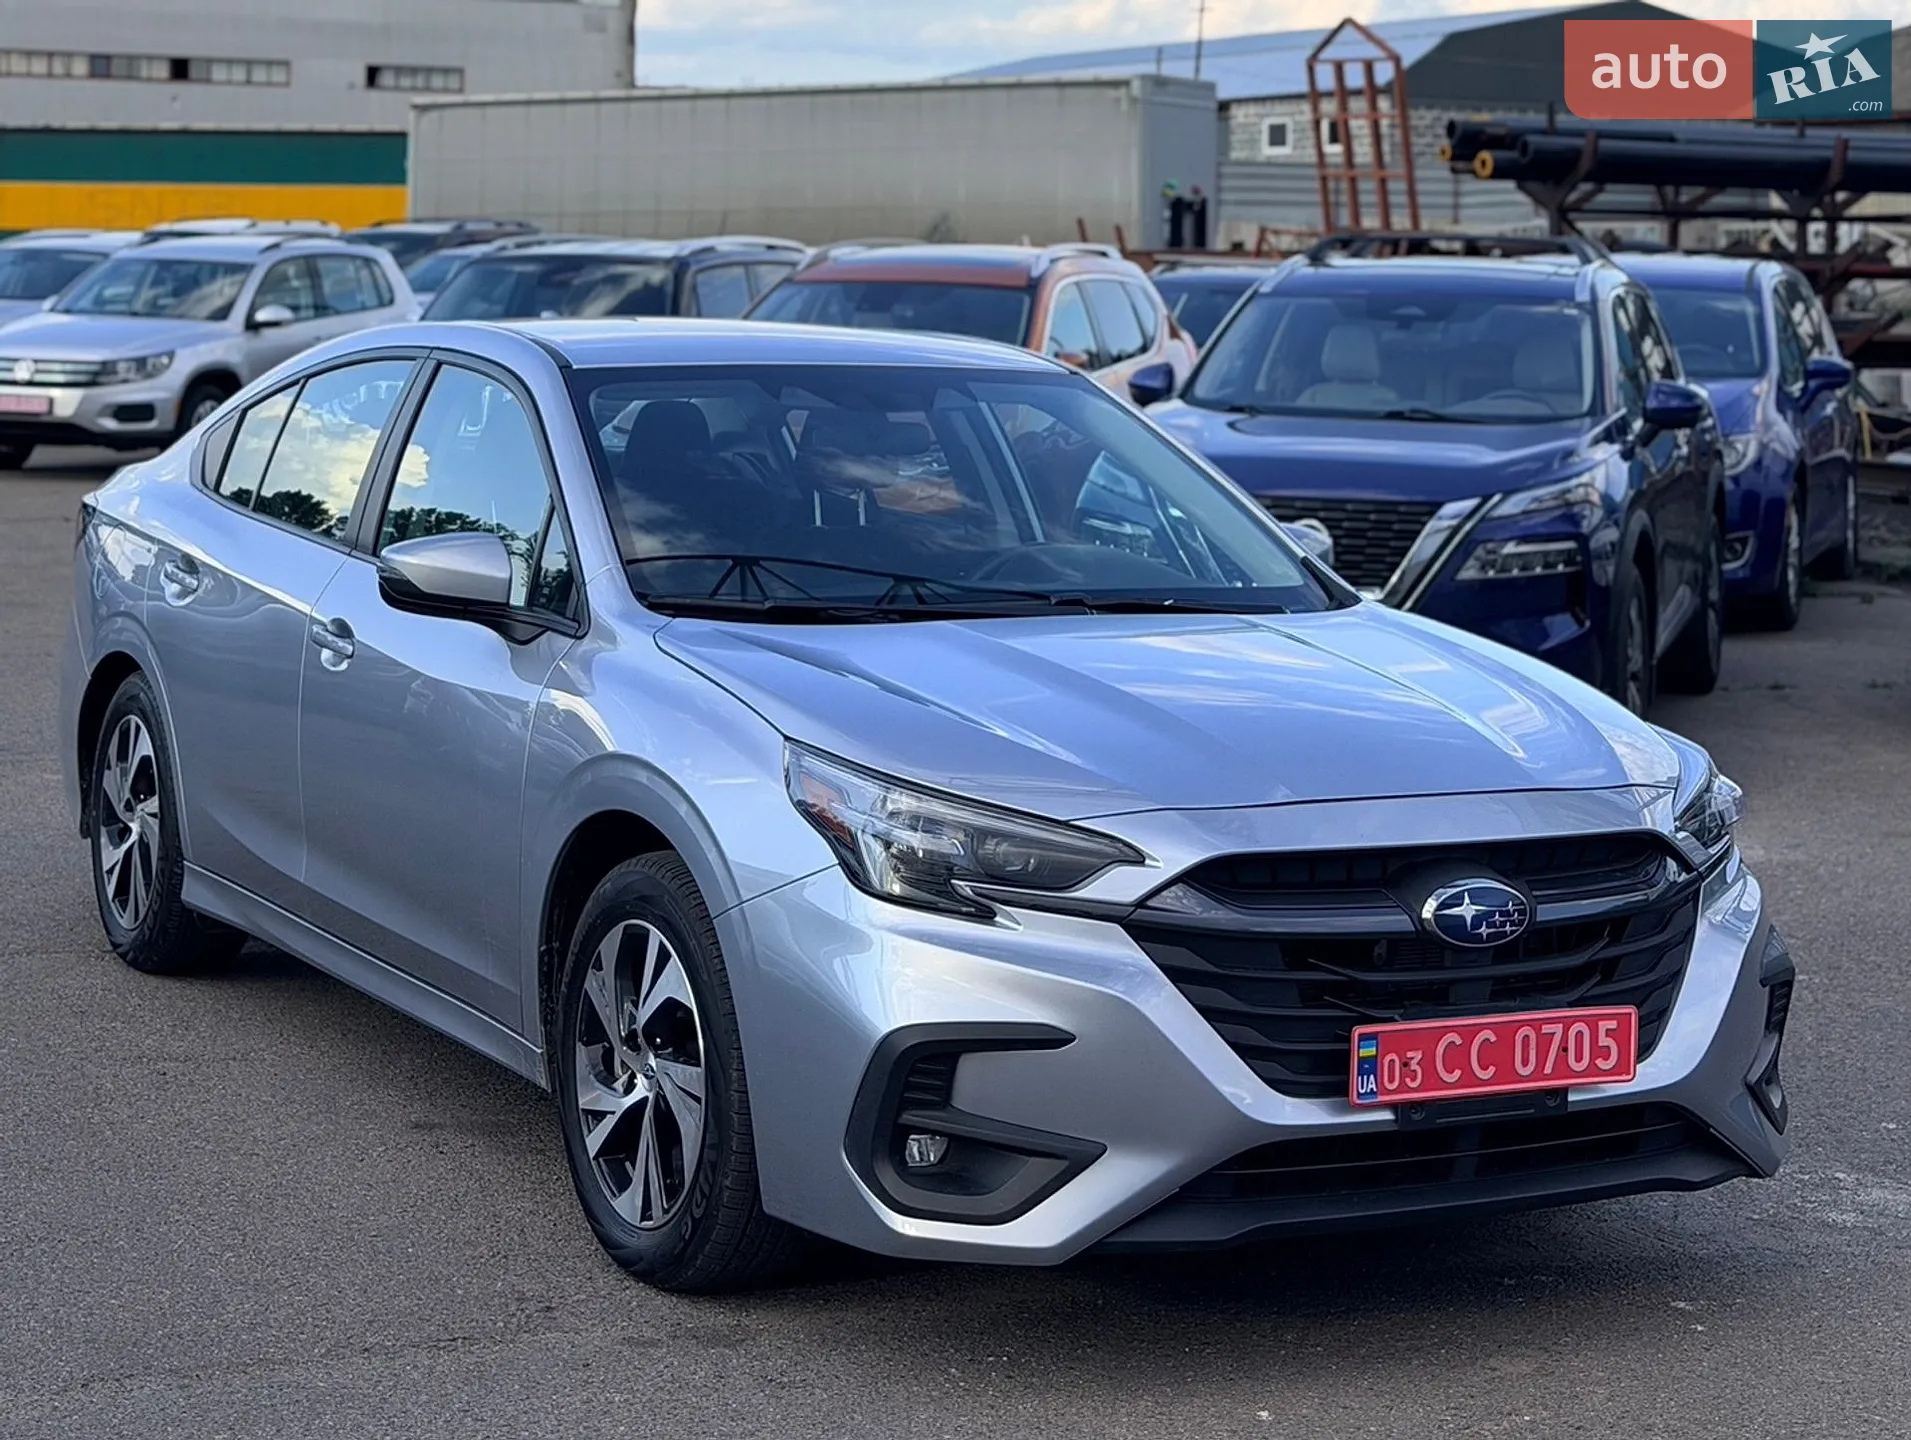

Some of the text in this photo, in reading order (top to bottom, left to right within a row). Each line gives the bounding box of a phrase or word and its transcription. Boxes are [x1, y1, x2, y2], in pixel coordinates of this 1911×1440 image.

[1382, 1020, 1618, 1090] 03 CC 0705
[1358, 1075, 1377, 1094] UA
